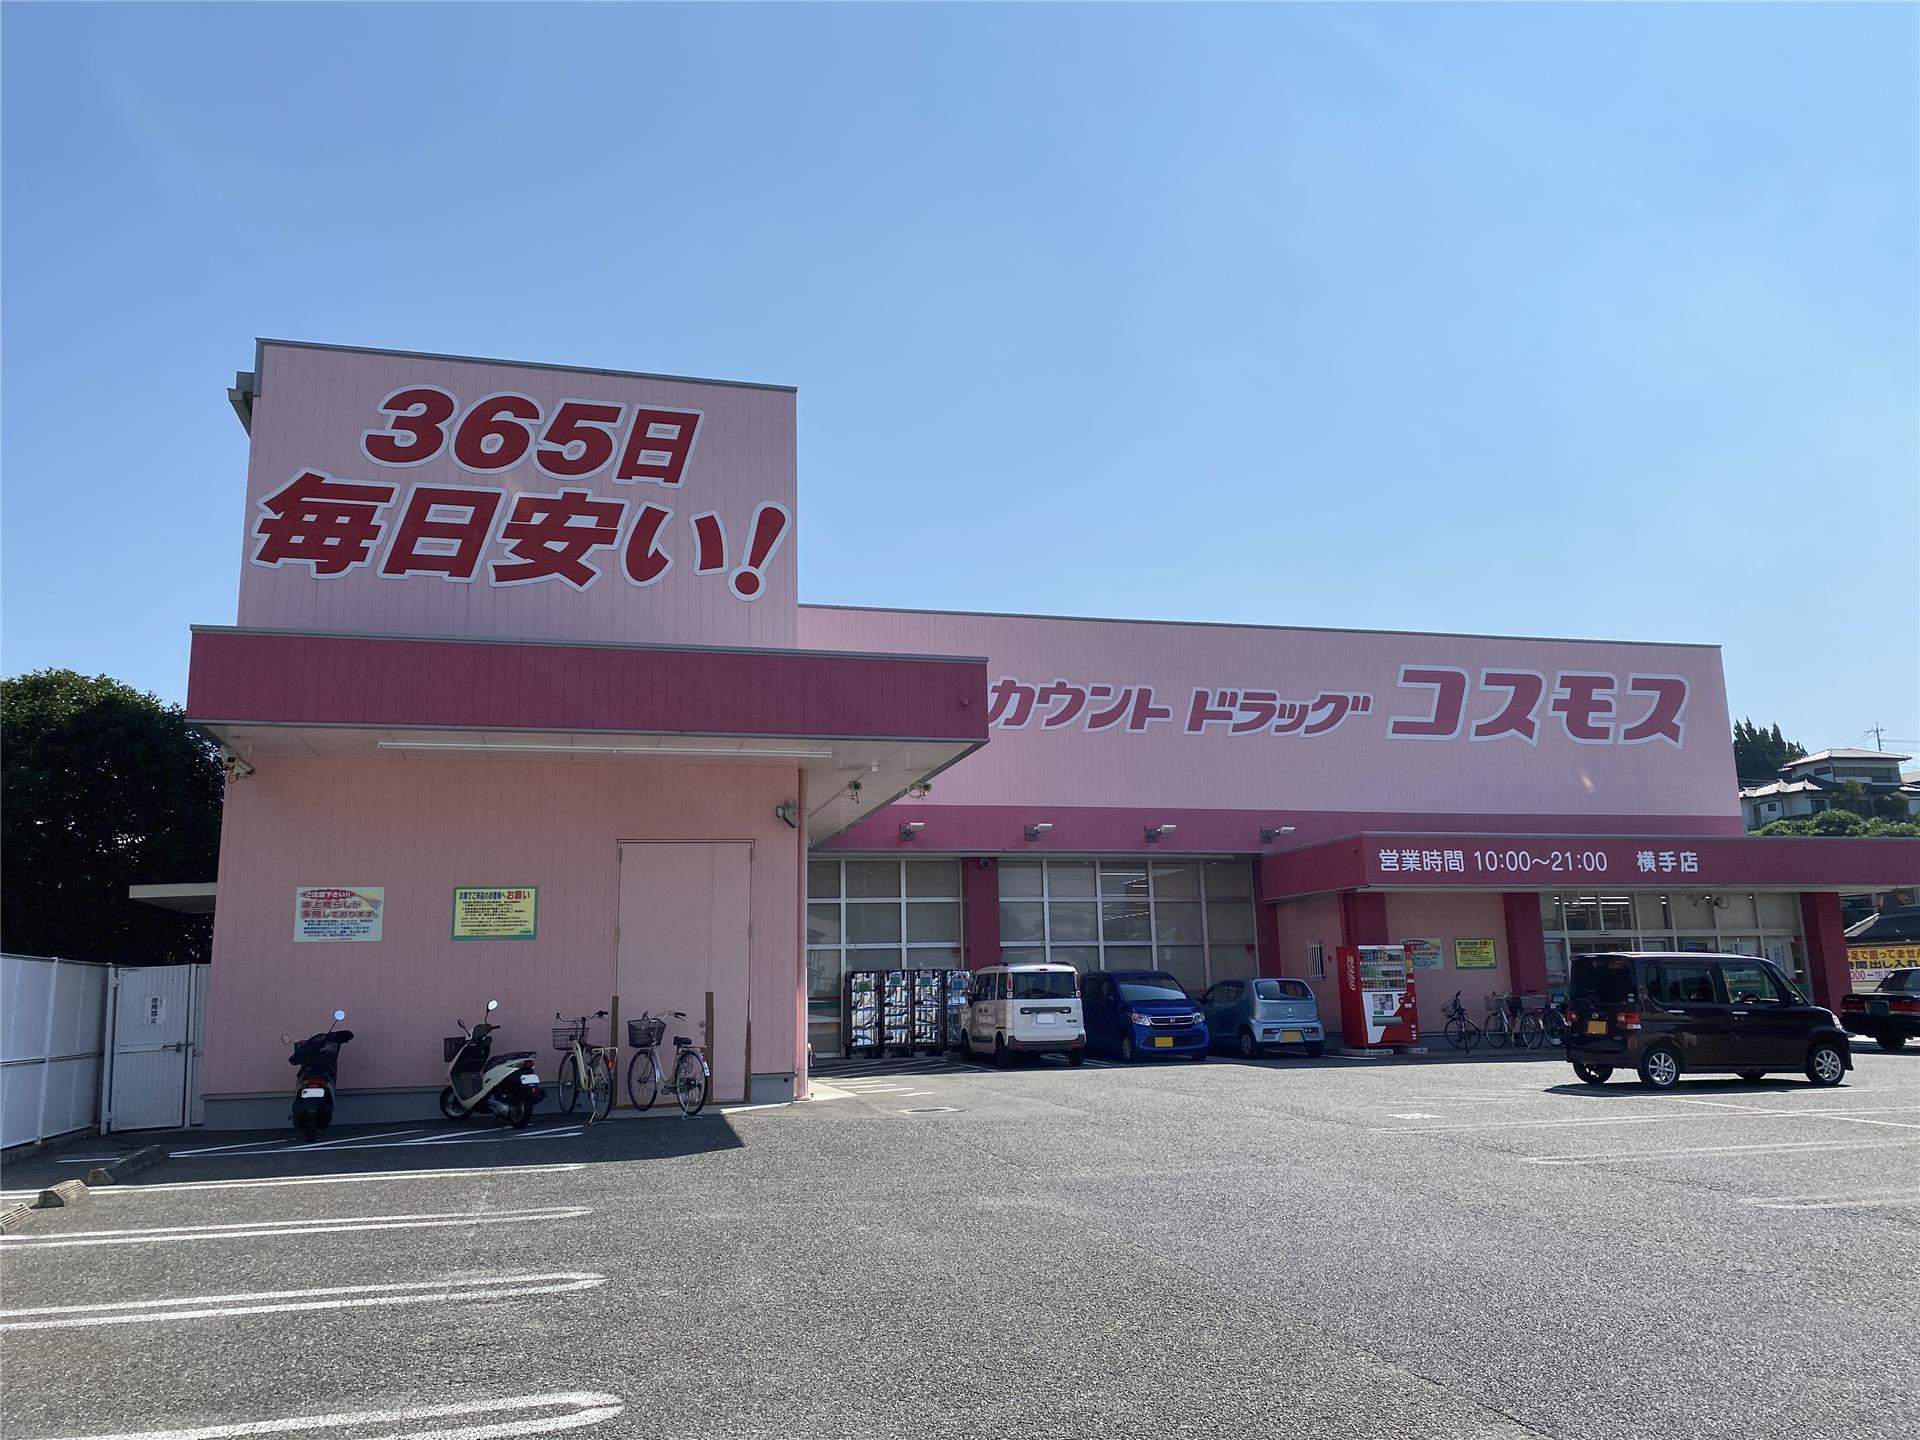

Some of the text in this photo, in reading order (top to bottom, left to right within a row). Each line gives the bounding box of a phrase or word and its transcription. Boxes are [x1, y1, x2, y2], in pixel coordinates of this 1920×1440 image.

[362, 386, 702, 486] 365日
[252, 469, 789, 598] 毎日安い!
[1185, 687, 1372, 737] ドラッグ
[1387, 665, 1689, 748] コスモス
[1379, 849, 1465, 873] 営業時間
[1636, 850, 1698, 873] 横手店
